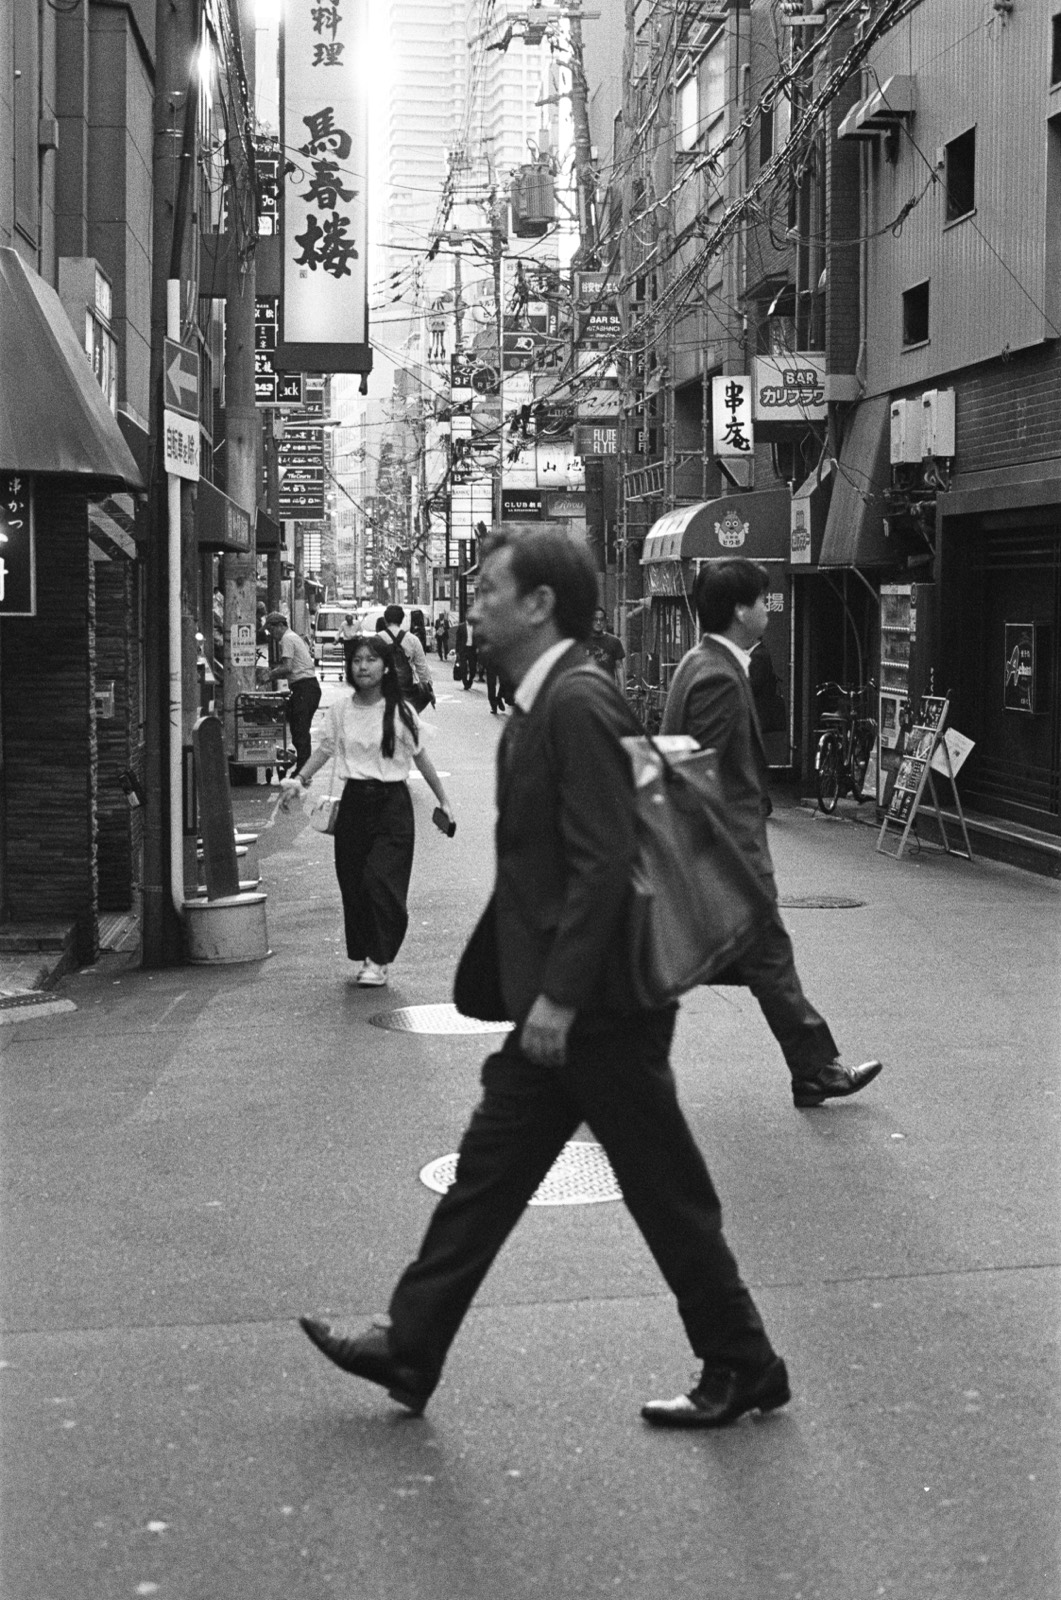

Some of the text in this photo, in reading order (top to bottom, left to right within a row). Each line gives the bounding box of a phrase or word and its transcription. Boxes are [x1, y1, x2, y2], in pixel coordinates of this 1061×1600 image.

[311, 0, 345, 67] 料理
[293, 107, 359, 279] 馬春楼
[550, 315, 557, 334] 3F
[590, 316, 608, 324] BAR
[455, 377, 469, 385] 3F
[785, 371, 815, 385] BAR
[719, 380, 751, 452] 串庵
